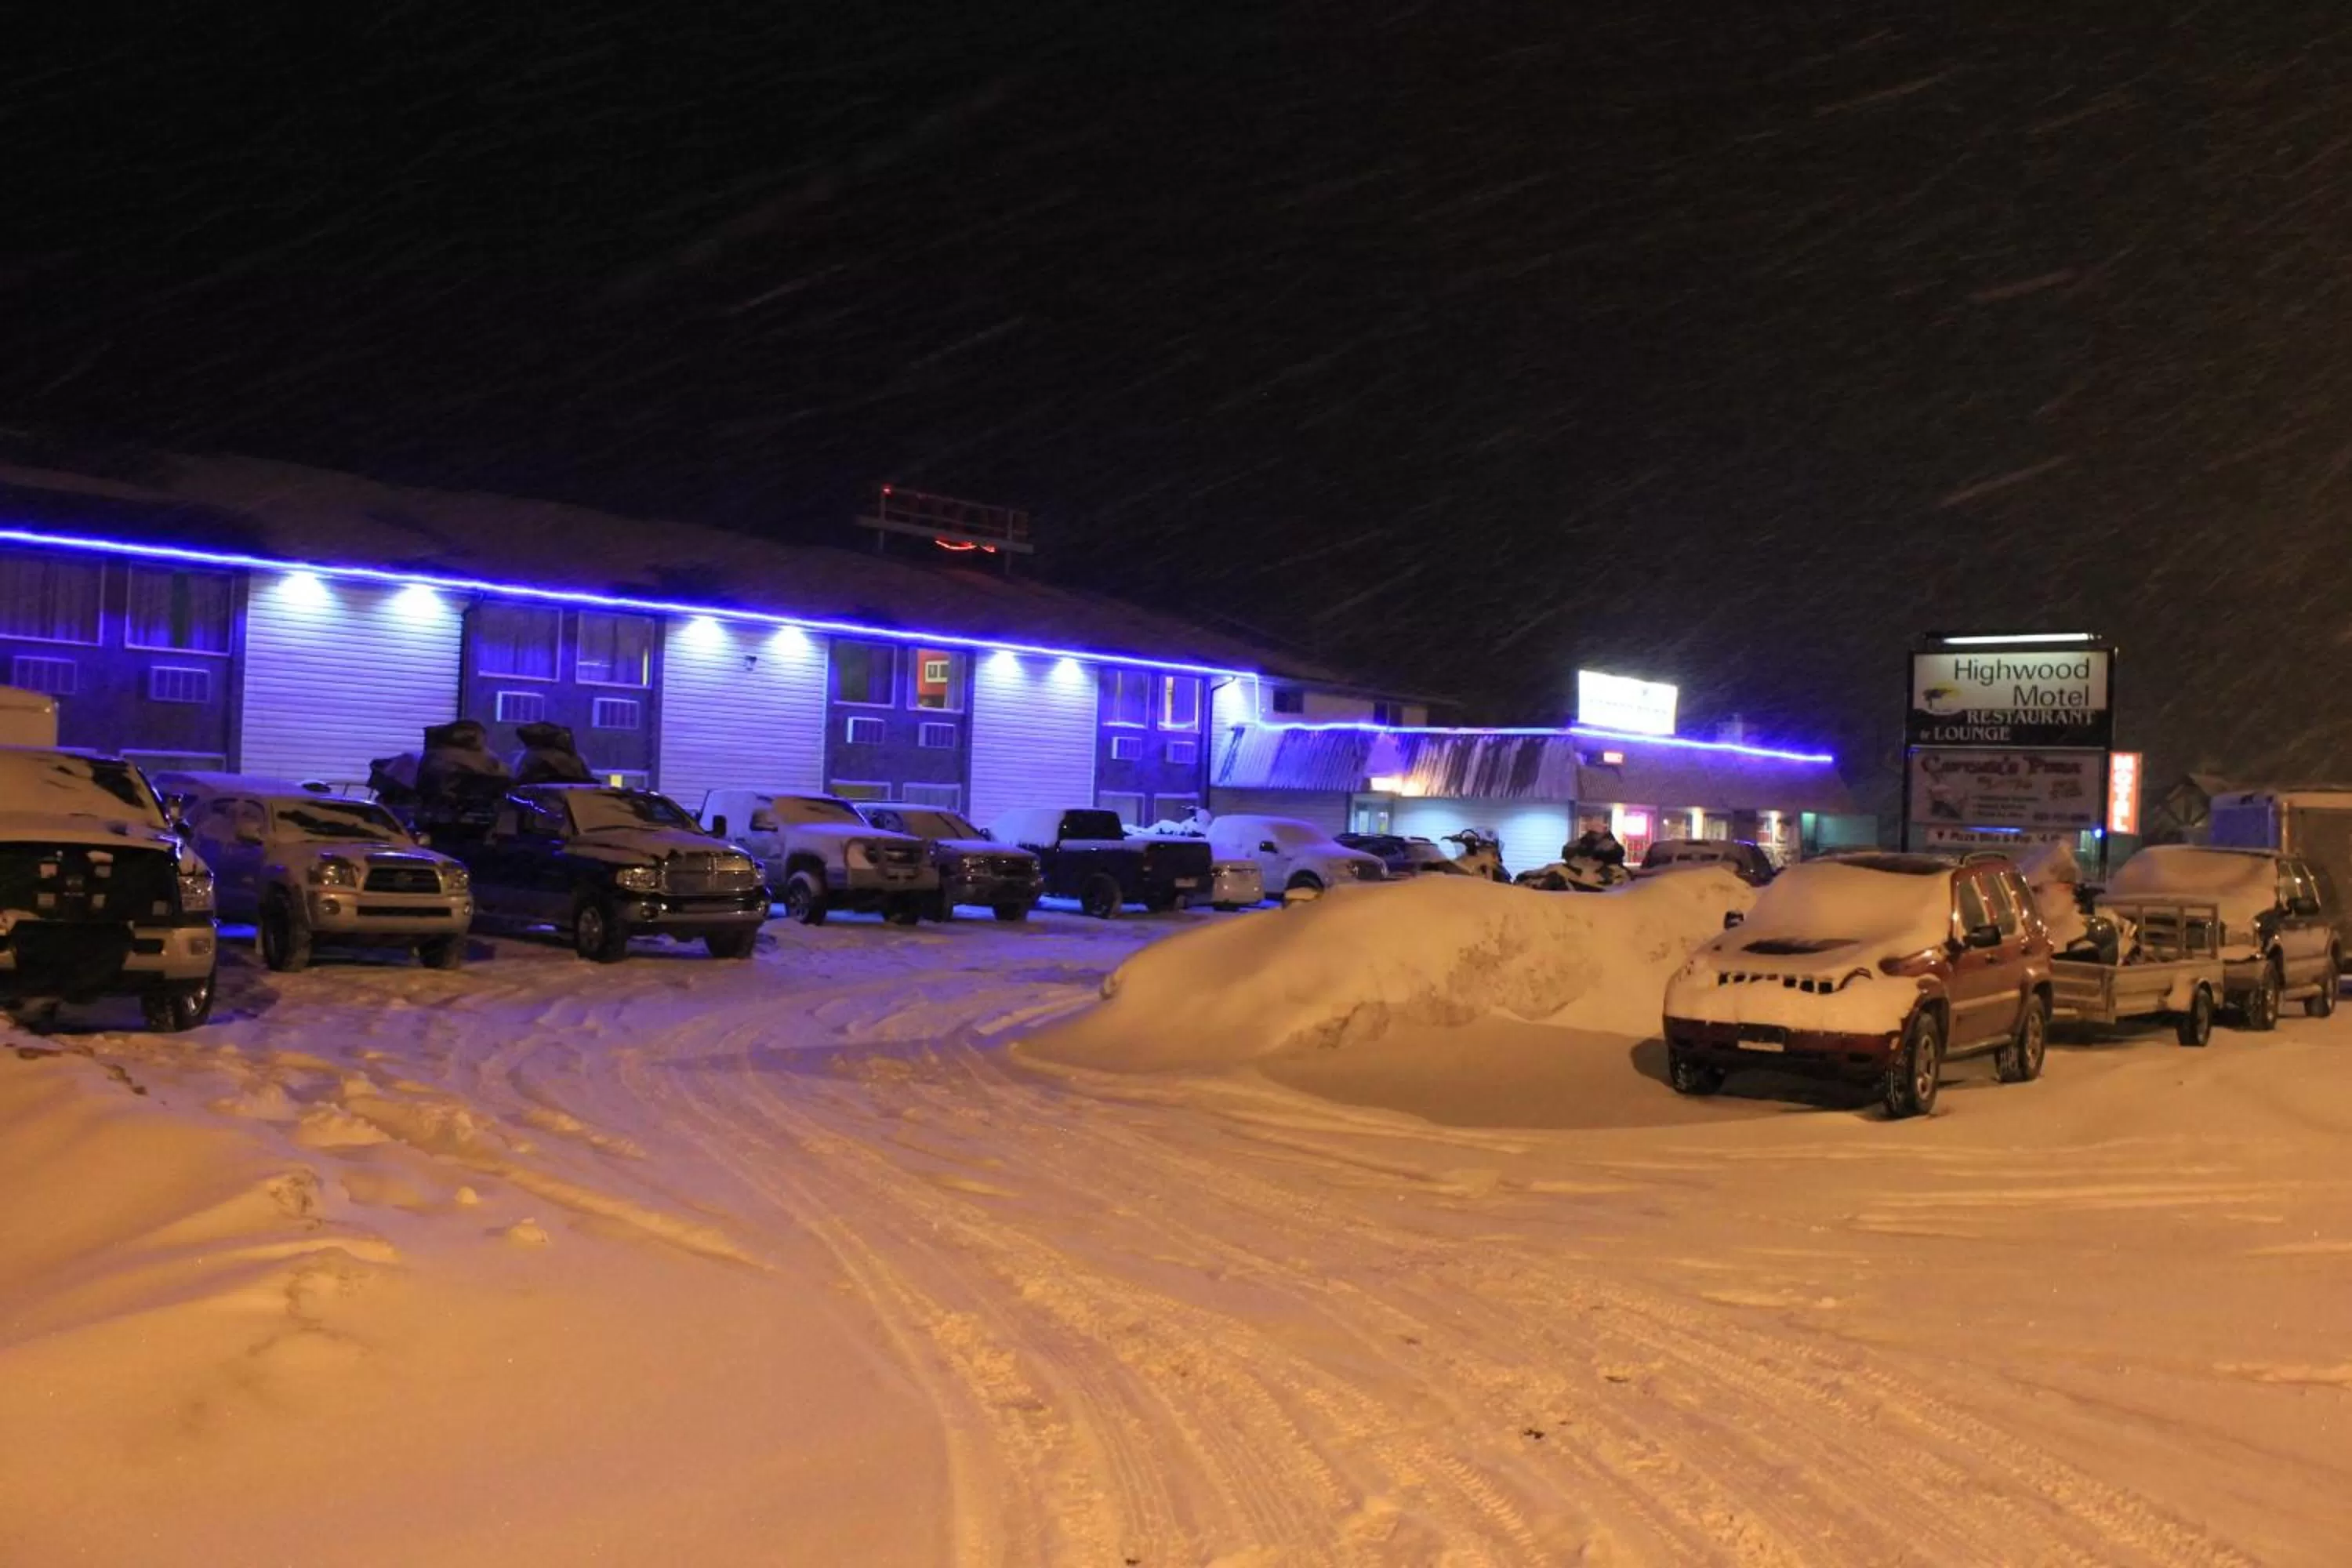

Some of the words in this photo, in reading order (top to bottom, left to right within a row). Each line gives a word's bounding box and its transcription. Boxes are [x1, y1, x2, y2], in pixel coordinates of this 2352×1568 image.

[1954, 658, 2090, 687] Highwood
[2013, 684, 2089, 706] Motel
[1966, 709, 2094, 726] RESTAURANT
[1934, 727, 2010, 741] LOUNGE
[2112, 754, 2133, 832] MOTEL
